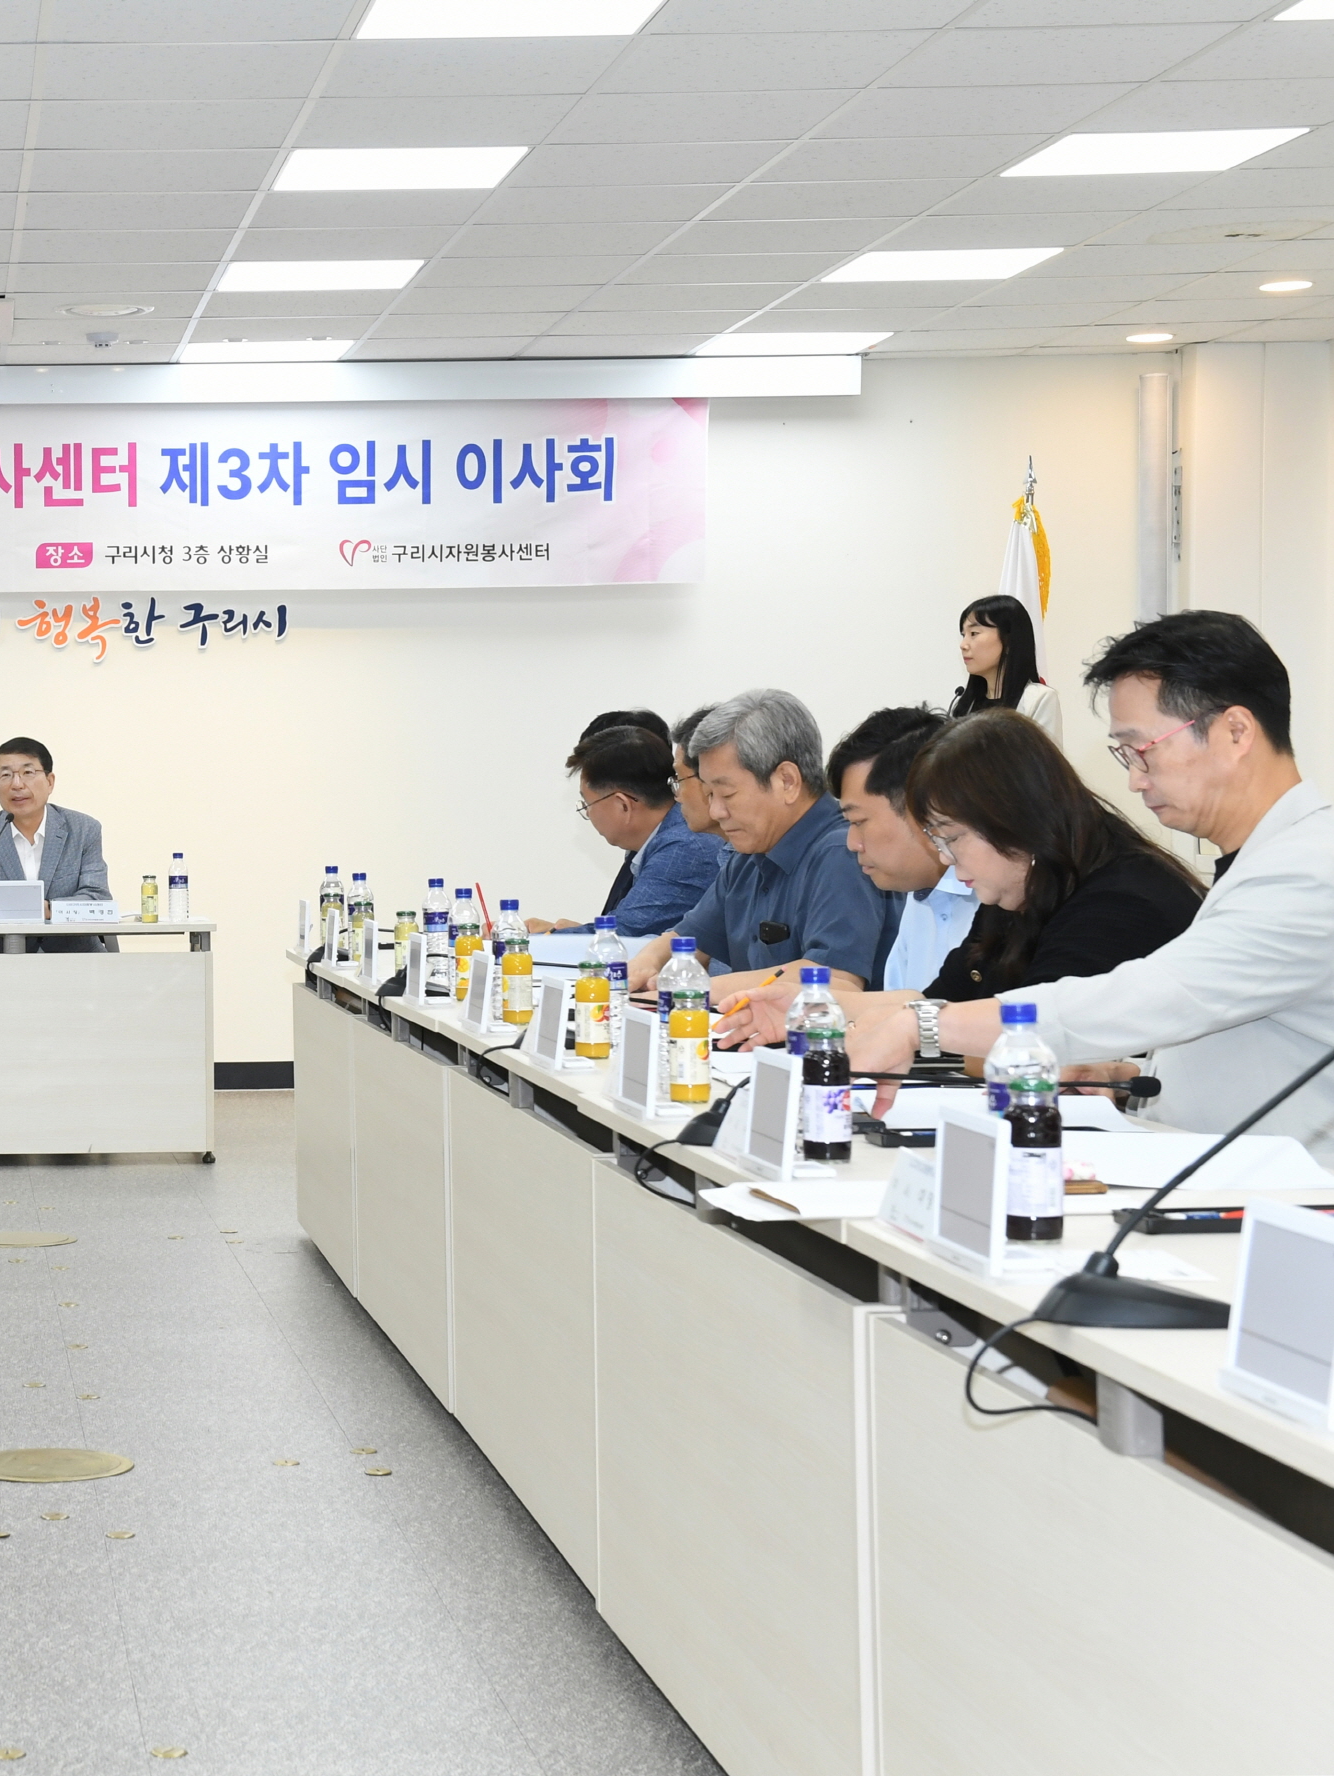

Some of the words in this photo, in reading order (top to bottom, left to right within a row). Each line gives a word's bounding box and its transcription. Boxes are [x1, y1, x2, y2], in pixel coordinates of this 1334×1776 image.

[160, 440, 310, 507] 제3차
[329, 439, 431, 505] 임시
[456, 436, 616, 504] 이사회
[45, 545, 85, 565] 장소
[104, 544, 173, 566] 구리시청
[184, 544, 210, 565] 3층
[217, 544, 269, 565] 상황실
[372, 545, 387, 553] 사단
[372, 554, 387, 563] 법인
[392, 541, 551, 563] 구리시자원봉사센터
[17, 596, 166, 661] 행복한
[179, 602, 288, 647] 구리시
